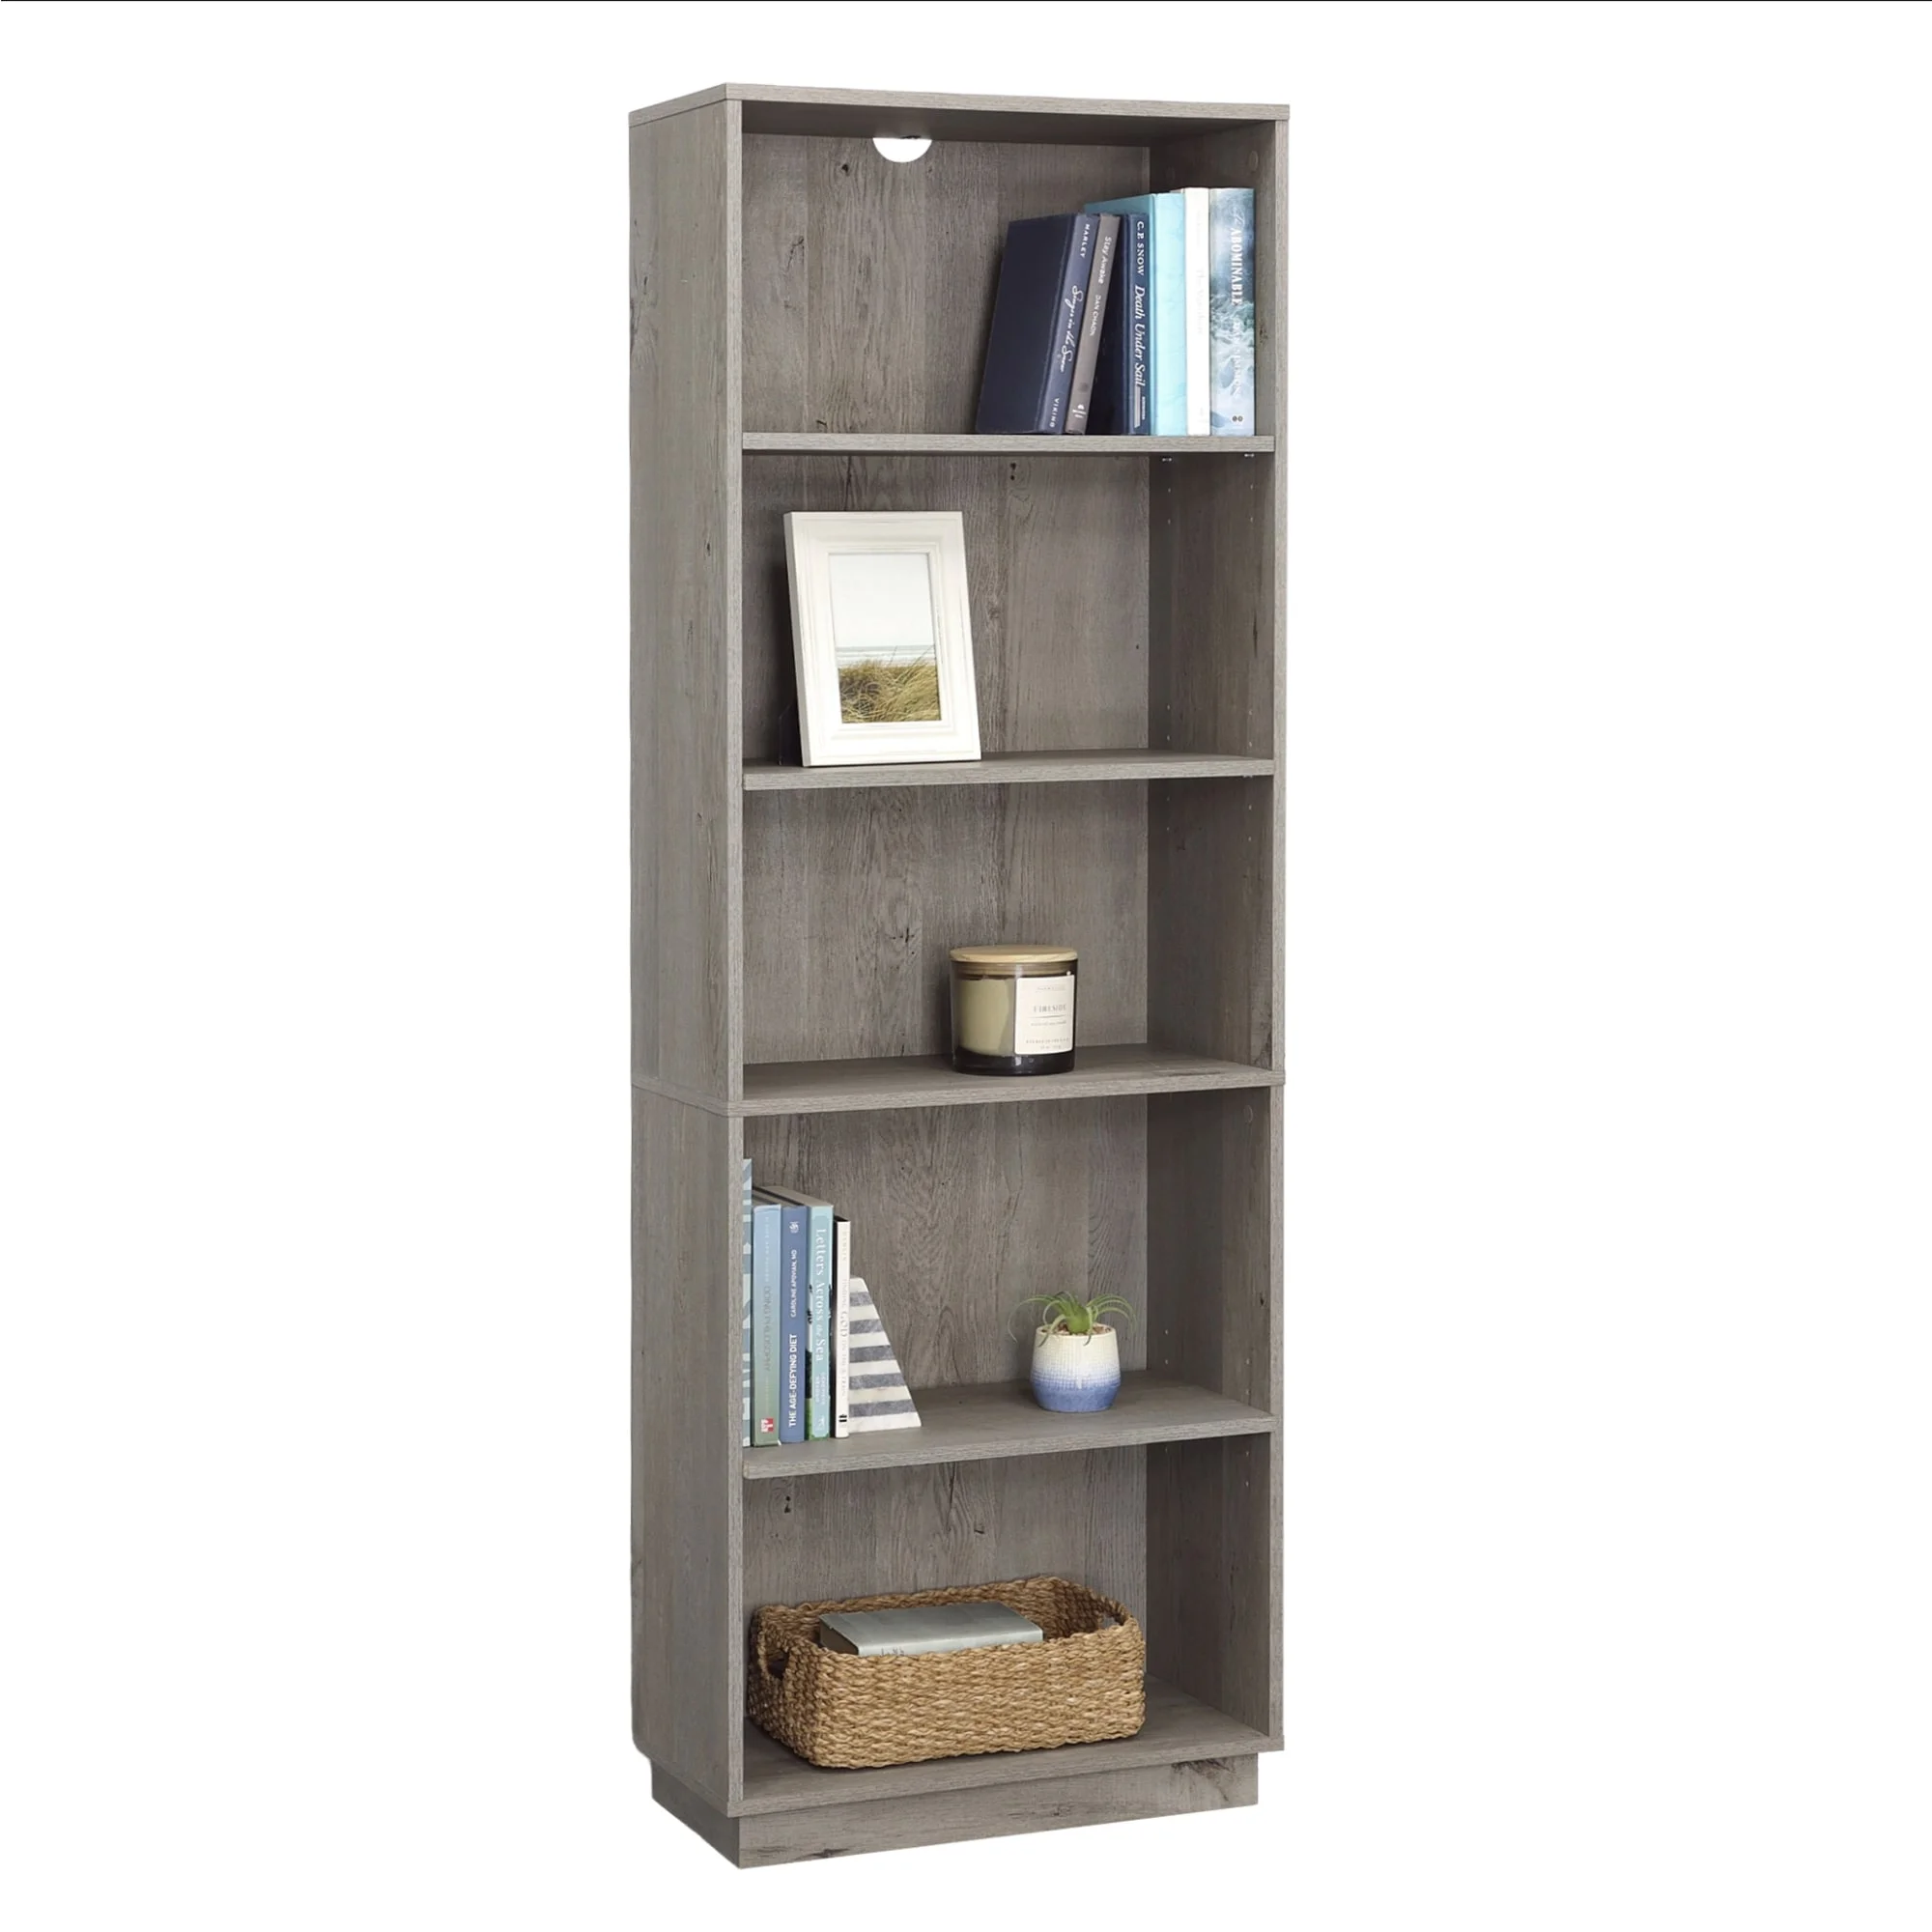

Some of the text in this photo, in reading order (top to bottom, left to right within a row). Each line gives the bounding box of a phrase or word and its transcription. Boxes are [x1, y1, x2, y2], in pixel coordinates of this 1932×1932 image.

[1098, 236, 1113, 284] Stay Awake
[1136, 243, 1145, 275] SNOW
[1231, 228, 1243, 306] ABOMINABLE
[1094, 295, 1102, 310] DAN
[1134, 285, 1147, 388] Death Under Sail
[1049, 398, 1060, 428] VIKING
[815, 1229, 828, 1276] Letters
[815, 1280, 827, 1321] Across
[815, 1338, 826, 1362] Sea
[788, 1333, 798, 1428] THE AGE-DEFYING DIET
